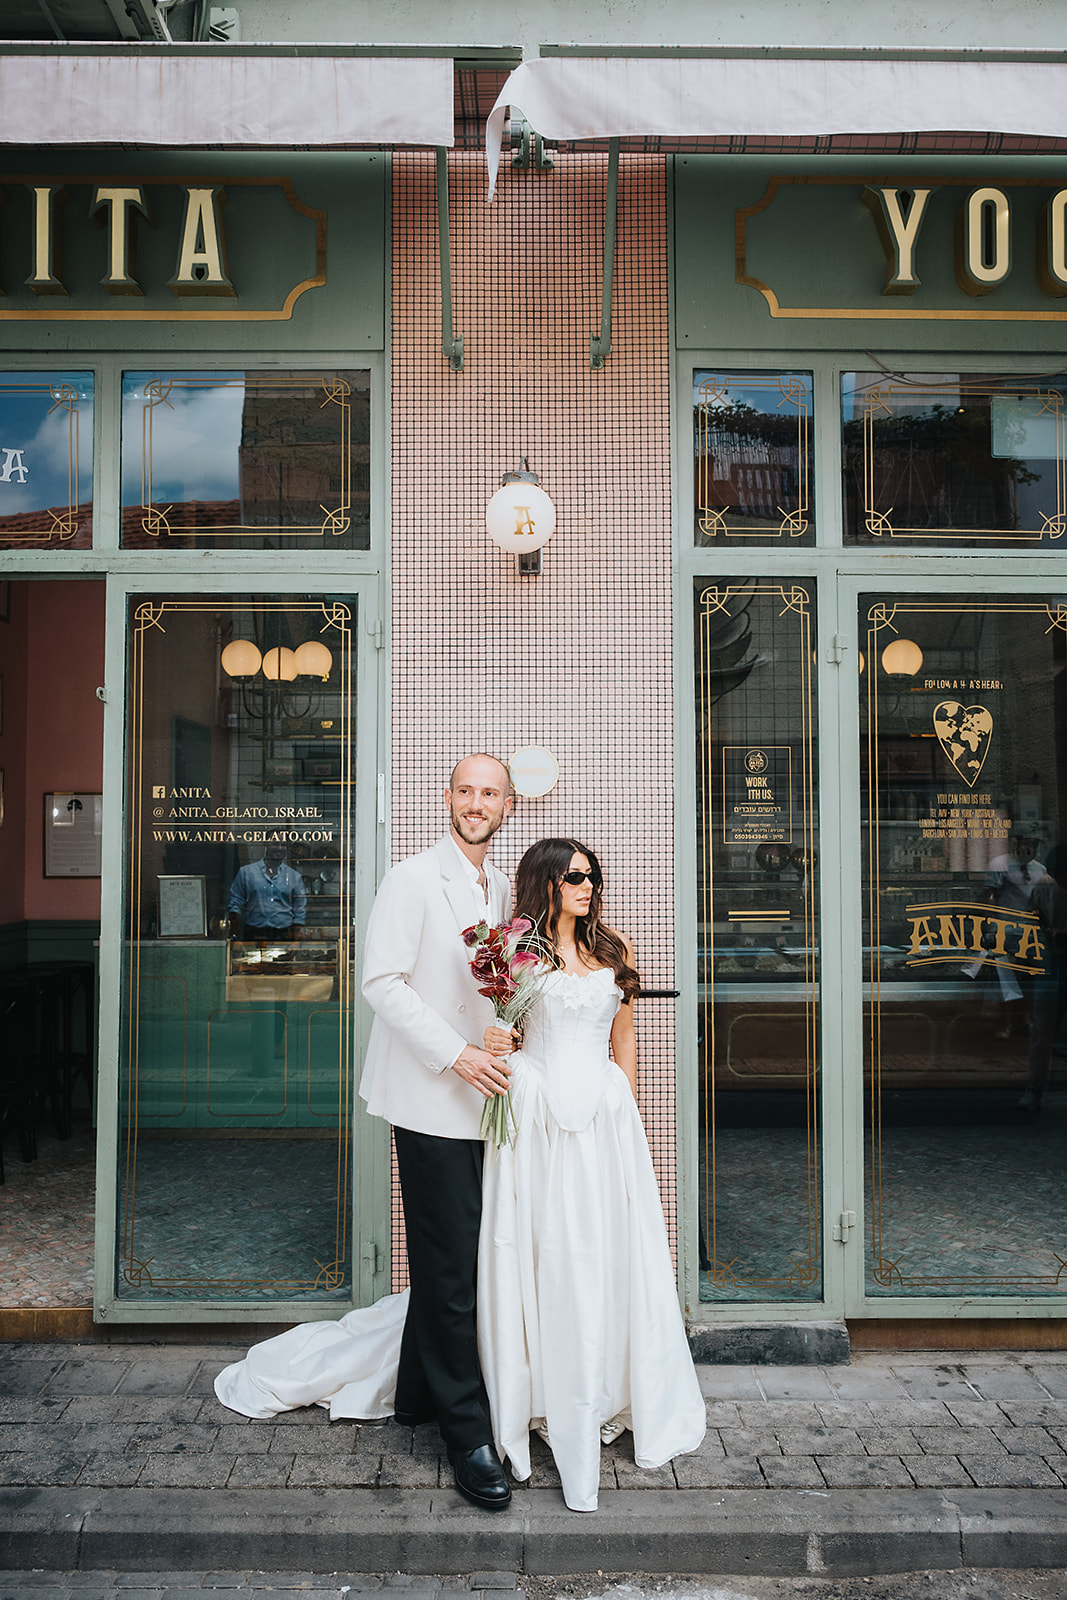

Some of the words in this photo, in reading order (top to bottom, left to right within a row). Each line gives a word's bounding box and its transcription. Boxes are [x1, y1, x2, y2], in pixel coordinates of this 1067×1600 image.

[513, 505, 536, 535] A
[745, 776, 768, 788] WORK
[169, 787, 212, 799] ANITA
[937, 793, 948, 805] YOU
[948, 793, 958, 805] CAN
[959, 793, 971, 805] FIND
[971, 793, 979, 805] US
[152, 807, 165, 818] @
[168, 806, 323, 818] ANITA_GELATO_ISRAEL
[152, 830, 334, 843] WWW.ANITA-GELATO.COM
[906, 914, 1046, 961] ANITA
